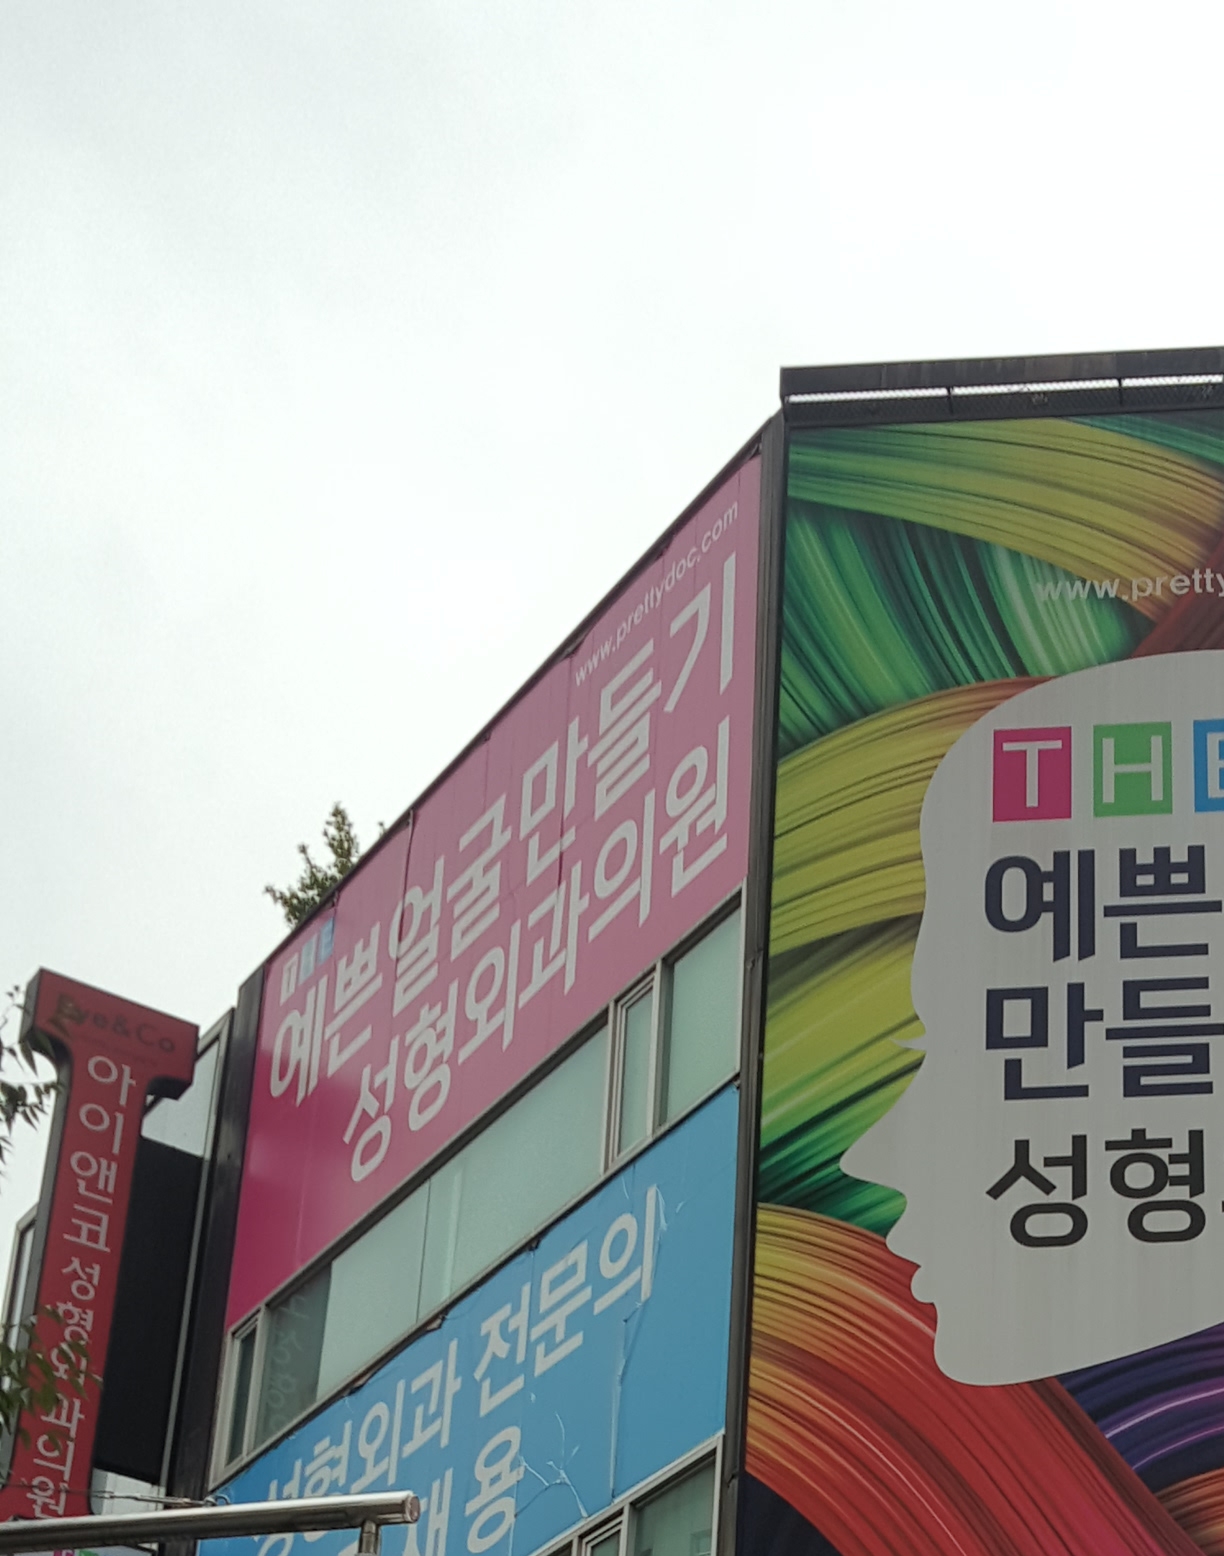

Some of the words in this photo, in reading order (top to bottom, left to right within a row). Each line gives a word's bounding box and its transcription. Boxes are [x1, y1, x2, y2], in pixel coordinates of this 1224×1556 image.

[574, 501, 739, 688] www.prettydoc.com
[342, 714, 730, 1183] 성형외과의원
[63, 1055, 136, 1253] 아이앤코
[473, 1184, 658, 1411] 전문의
